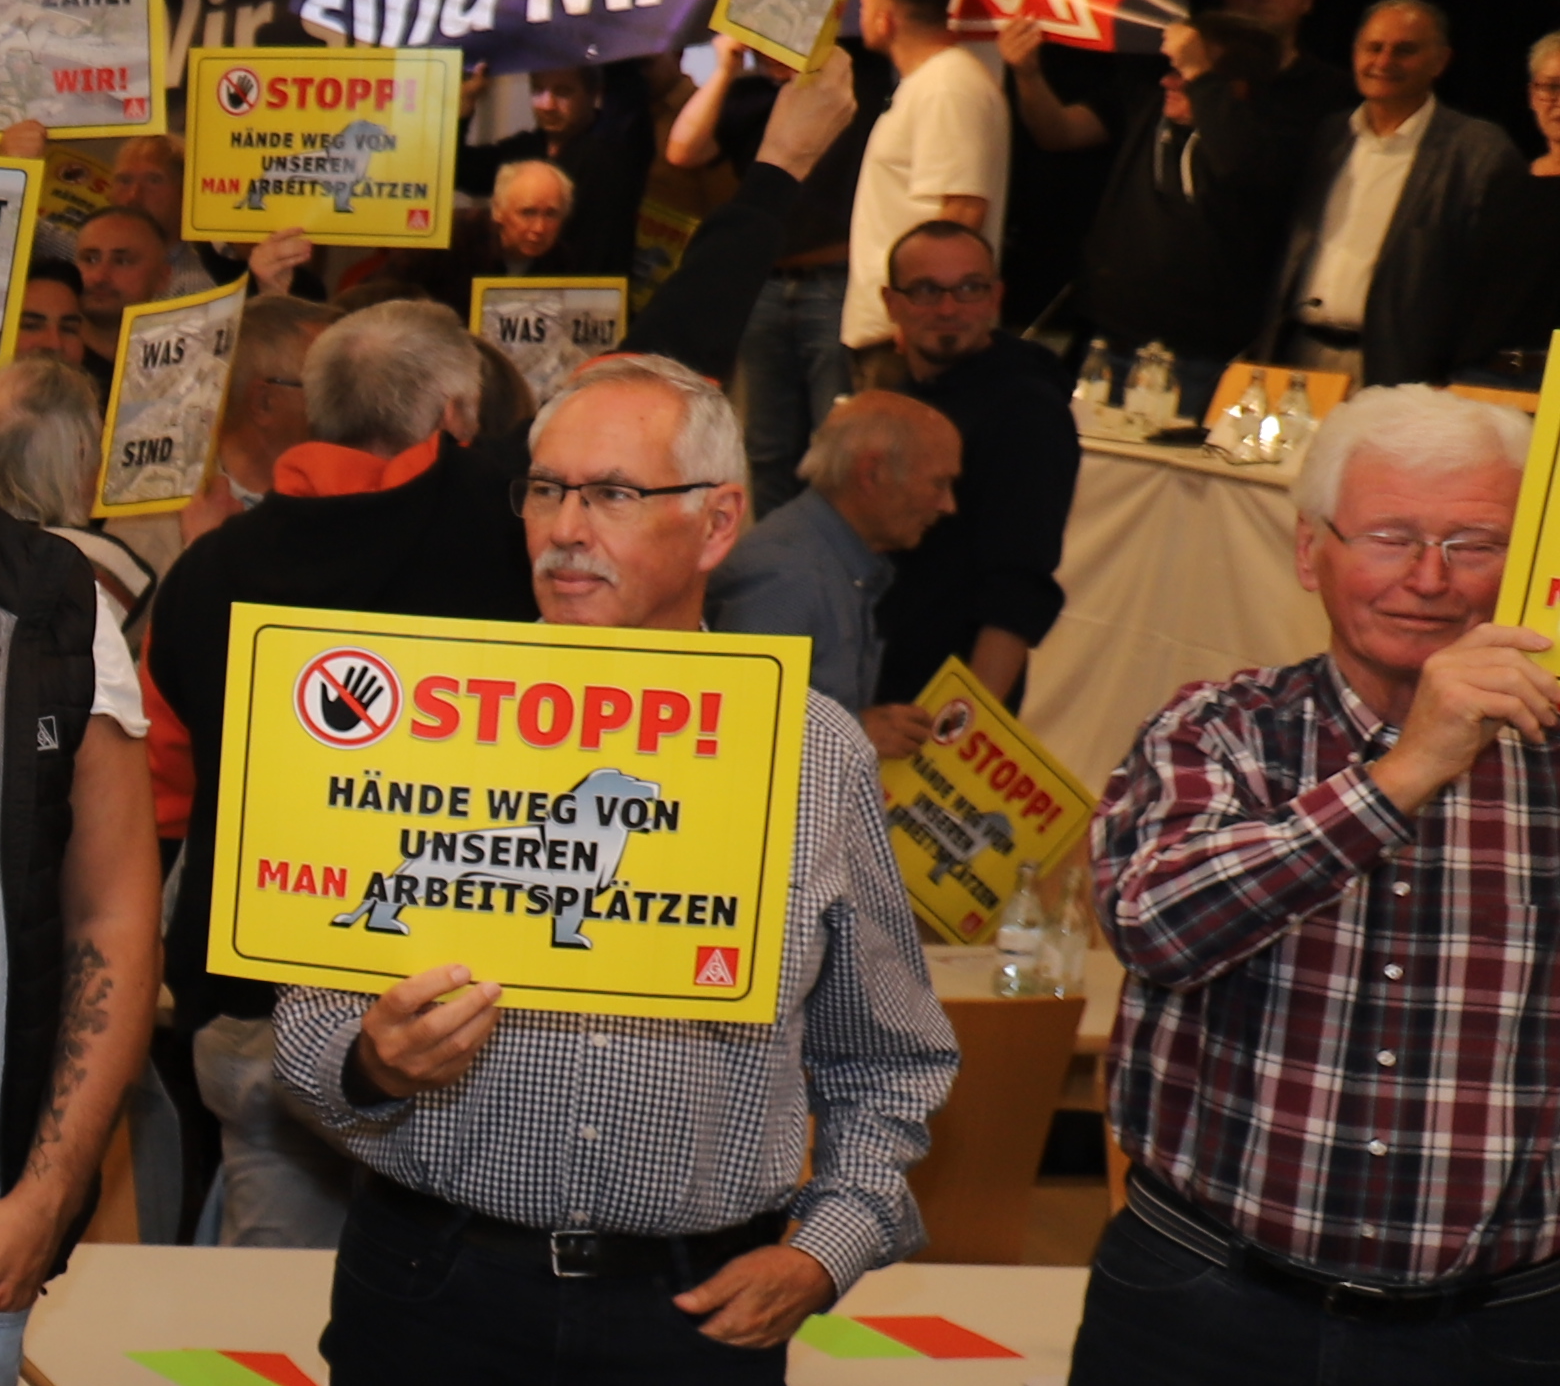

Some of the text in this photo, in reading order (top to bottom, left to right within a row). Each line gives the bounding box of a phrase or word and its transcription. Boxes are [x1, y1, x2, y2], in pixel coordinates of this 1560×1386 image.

[52, 67, 129, 95] WIR!
[265, 77, 417, 112] STOPP!
[231, 127, 397, 152] HÄNDE WEG VON
[262, 155, 356, 174] UNSEREN
[201, 177, 428, 199] MAN ARBEITSPLÄTZEN
[499, 318, 547, 343] WAS
[142, 337, 187, 369] WAS
[122, 437, 175, 468] SIND
[409, 675, 723, 758] STOPP!
[958, 729, 1064, 835] STOPP!
[327, 769, 681, 833] HÄNDE WEG VON
[398, 828, 600, 873] UNSEREN
[255, 858, 740, 928] MAN ARBEITSPLÄTZEN
